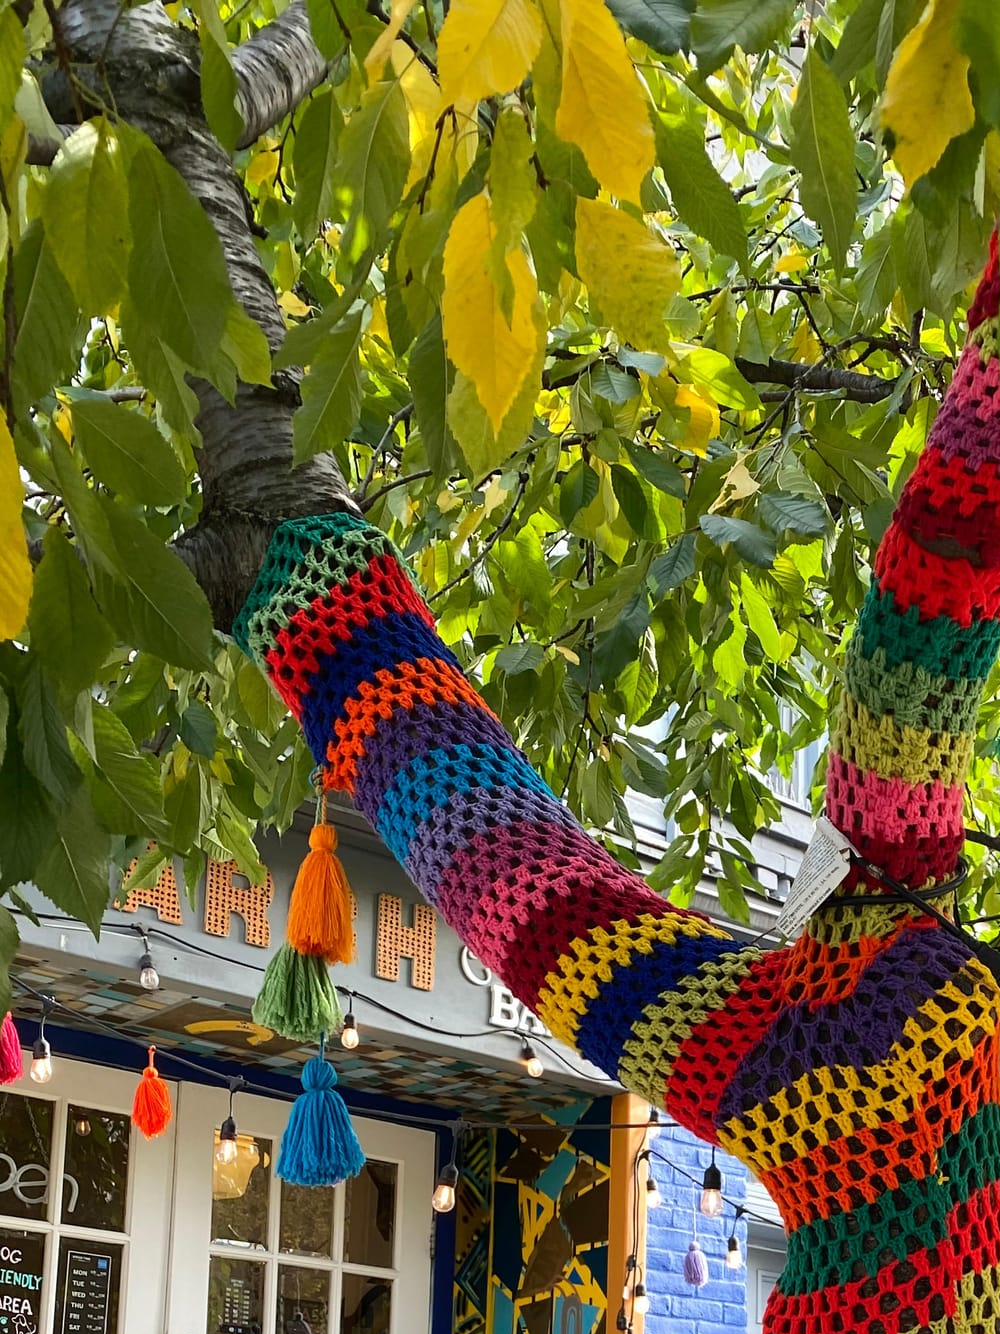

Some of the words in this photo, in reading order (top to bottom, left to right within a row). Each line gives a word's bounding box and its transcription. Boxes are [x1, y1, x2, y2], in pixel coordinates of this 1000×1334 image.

[113, 840, 437, 992] ARH
[489, 984, 553, 1038] BA
[72, 1268, 88, 1277] MON
[72, 1279, 85, 1287] TUE
[71, 1290, 86, 1298] WED
[0, 1295, 33, 1315] REA
[70, 1301, 84, 1309] THU
[68, 1323, 81, 1331] SAT
